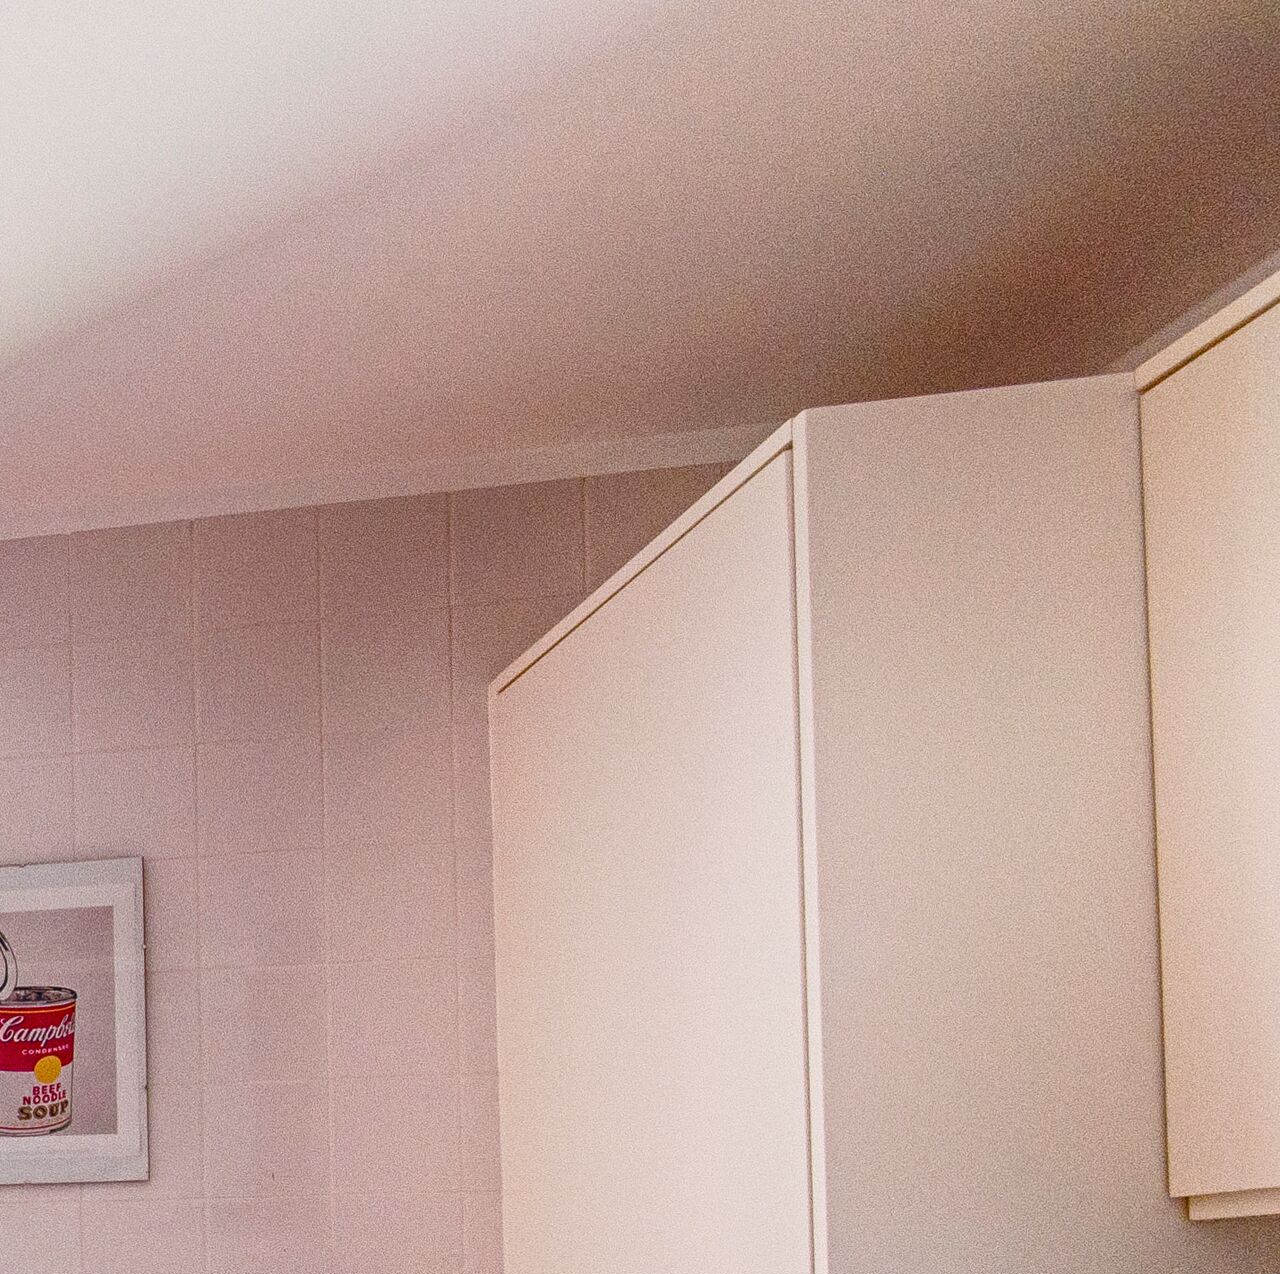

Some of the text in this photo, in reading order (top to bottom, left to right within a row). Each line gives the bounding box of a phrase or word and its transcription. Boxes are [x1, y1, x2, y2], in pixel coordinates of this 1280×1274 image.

[33, 1083, 61, 1096] BEEF
[23, 1090, 67, 1105] NOODLE
[17, 1099, 69, 1120] SOUP
